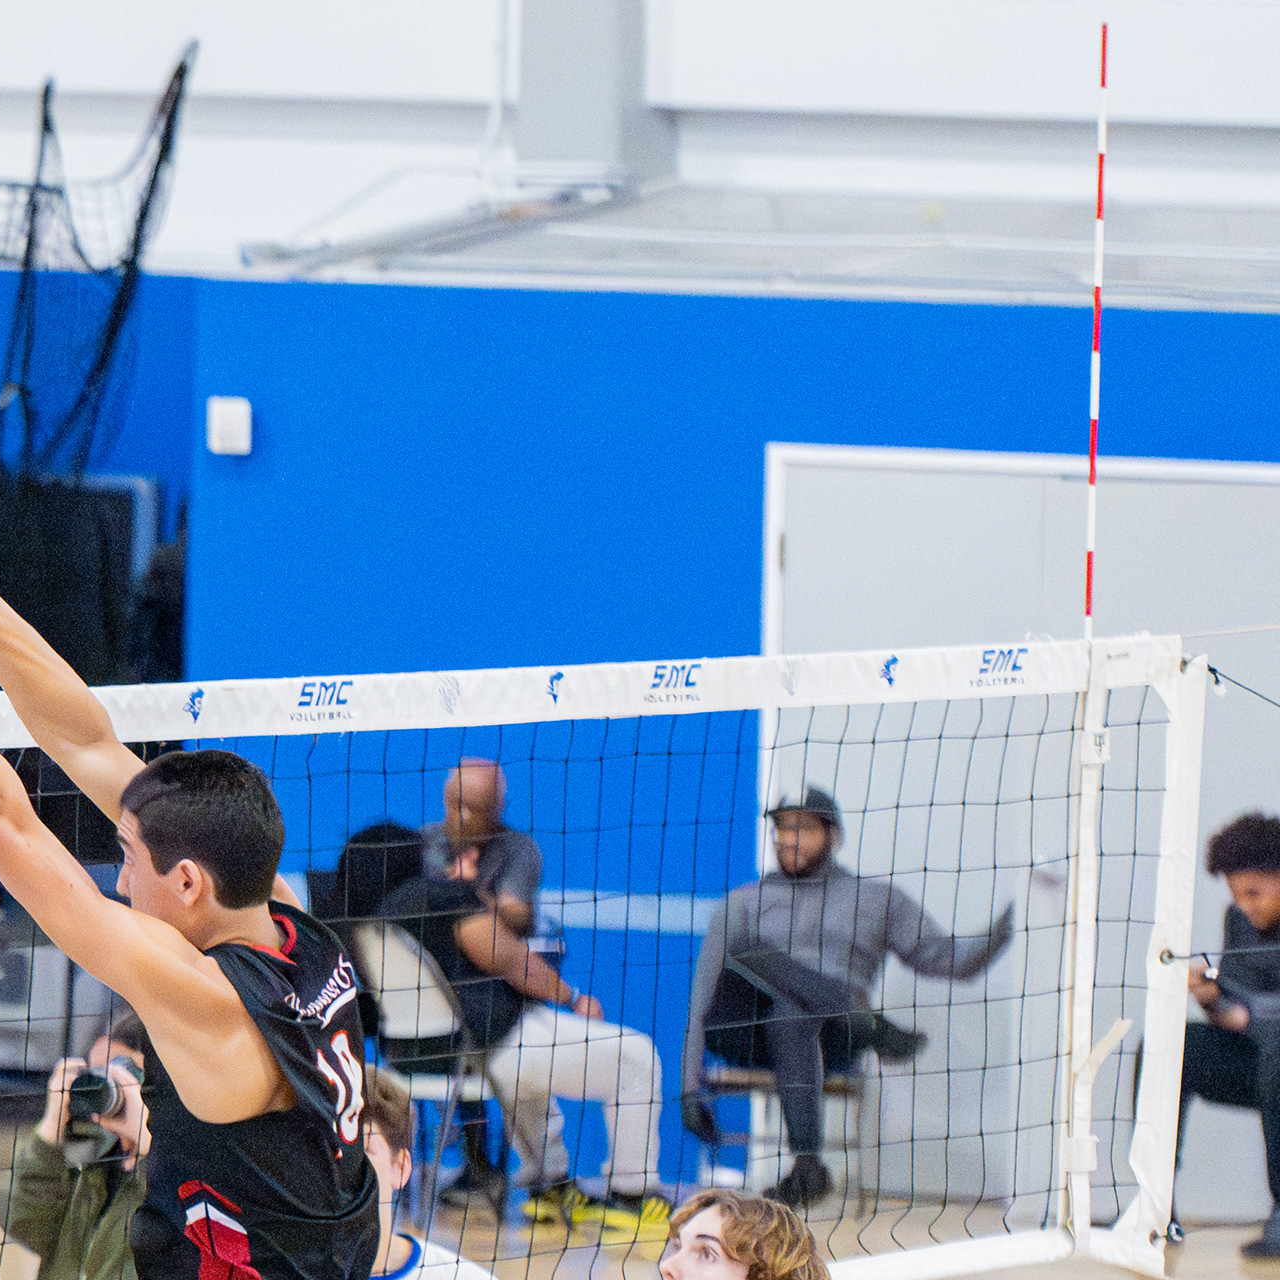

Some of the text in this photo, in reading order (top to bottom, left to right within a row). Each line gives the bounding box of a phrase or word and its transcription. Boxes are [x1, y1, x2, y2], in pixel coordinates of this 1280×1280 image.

[979, 648, 1029, 674] SMC
[650, 664, 702, 689] SMC
[297, 680, 354, 706] SMC
